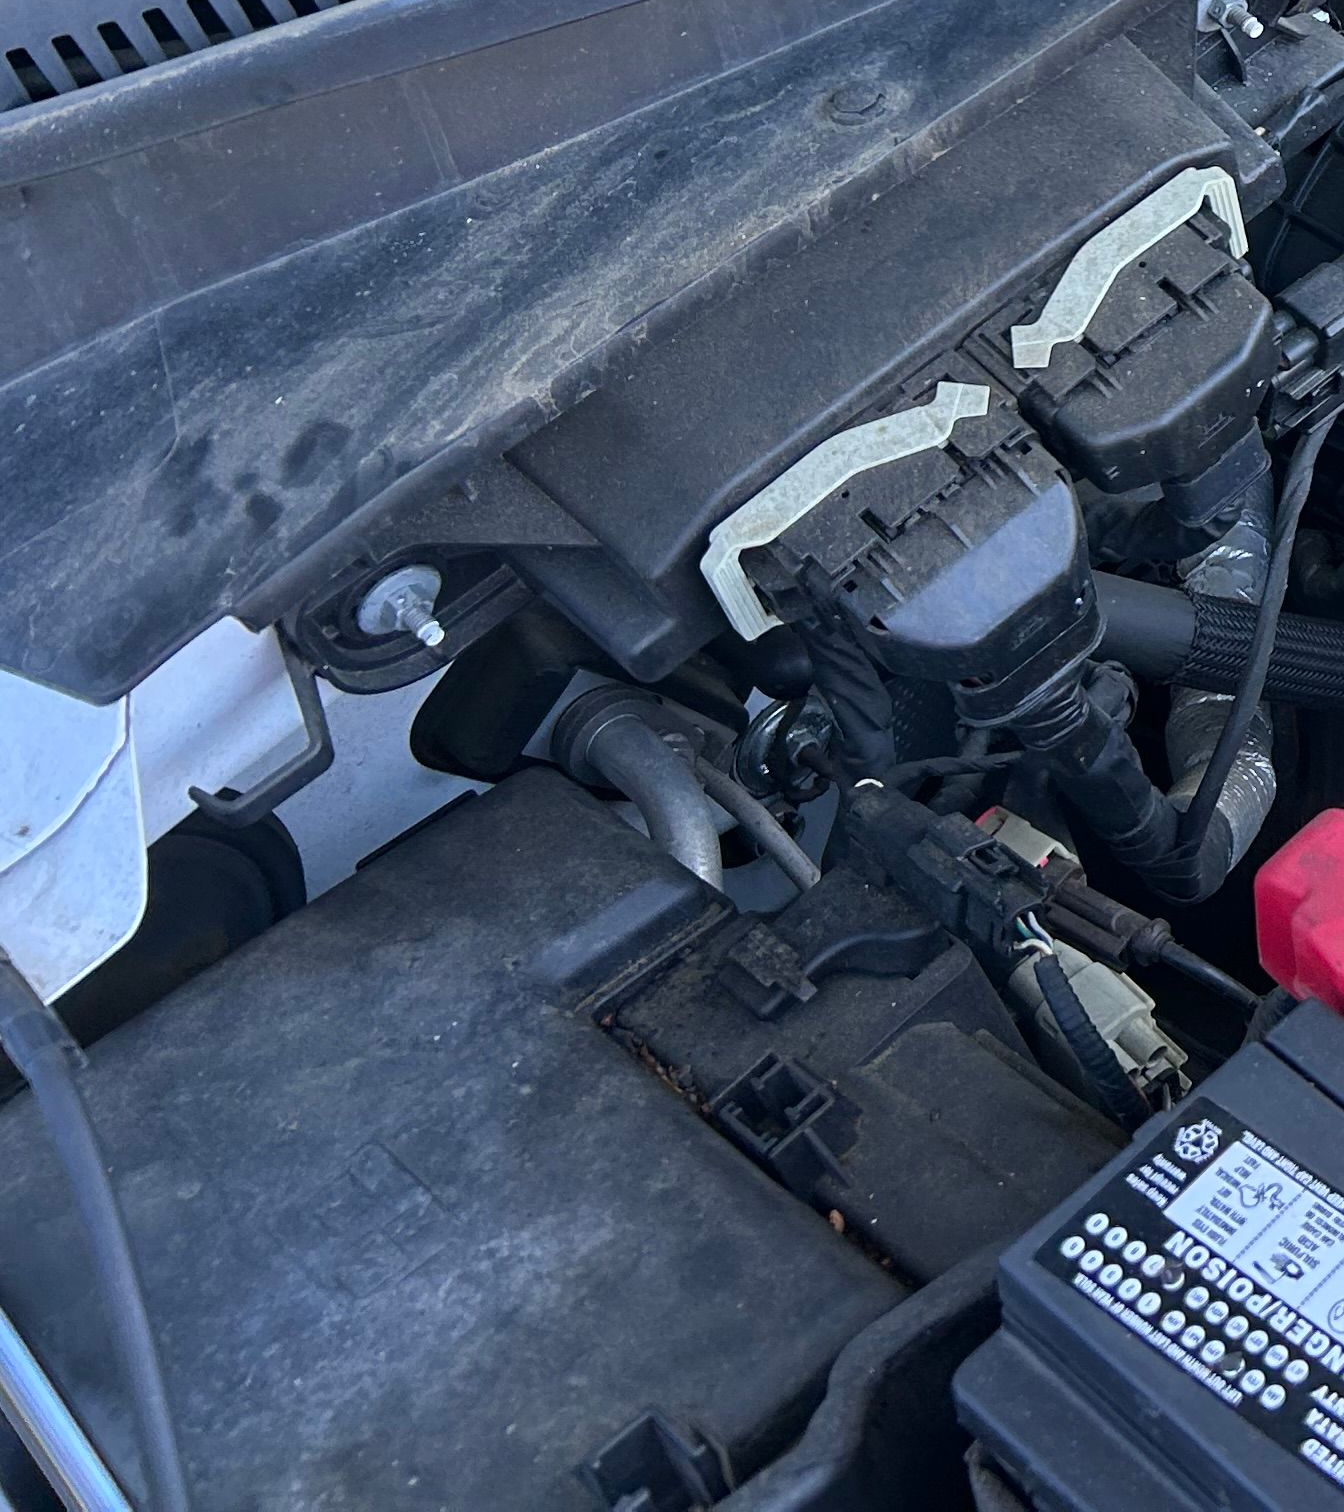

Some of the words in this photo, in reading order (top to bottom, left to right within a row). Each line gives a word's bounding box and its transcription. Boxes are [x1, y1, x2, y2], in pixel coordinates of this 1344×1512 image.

[1214, 1166, 1241, 1189] MEDICAL
[1233, 1165, 1252, 1179] HELP
[1293, 1169, 1313, 1186] CAP
[1195, 1204, 1237, 1236] IMMEDIATELY
[1228, 1210, 1246, 1226] WITH
[1277, 1236, 1320, 1269] SULFURIC
[1296, 1234, 1320, 1252] ACID
[1090, 1286, 1114, 1307] YEAR
[1119, 1307, 1153, 1336] NUMBER
[1147, 1329, 1171, 1349] LAST
[1164, 1342, 1186, 1360] AND
[1180, 1353, 1211, 1380] MONTH
[1204, 1372, 1226, 1392] OUT
[1220, 1384, 1242, 1403] LIFT
